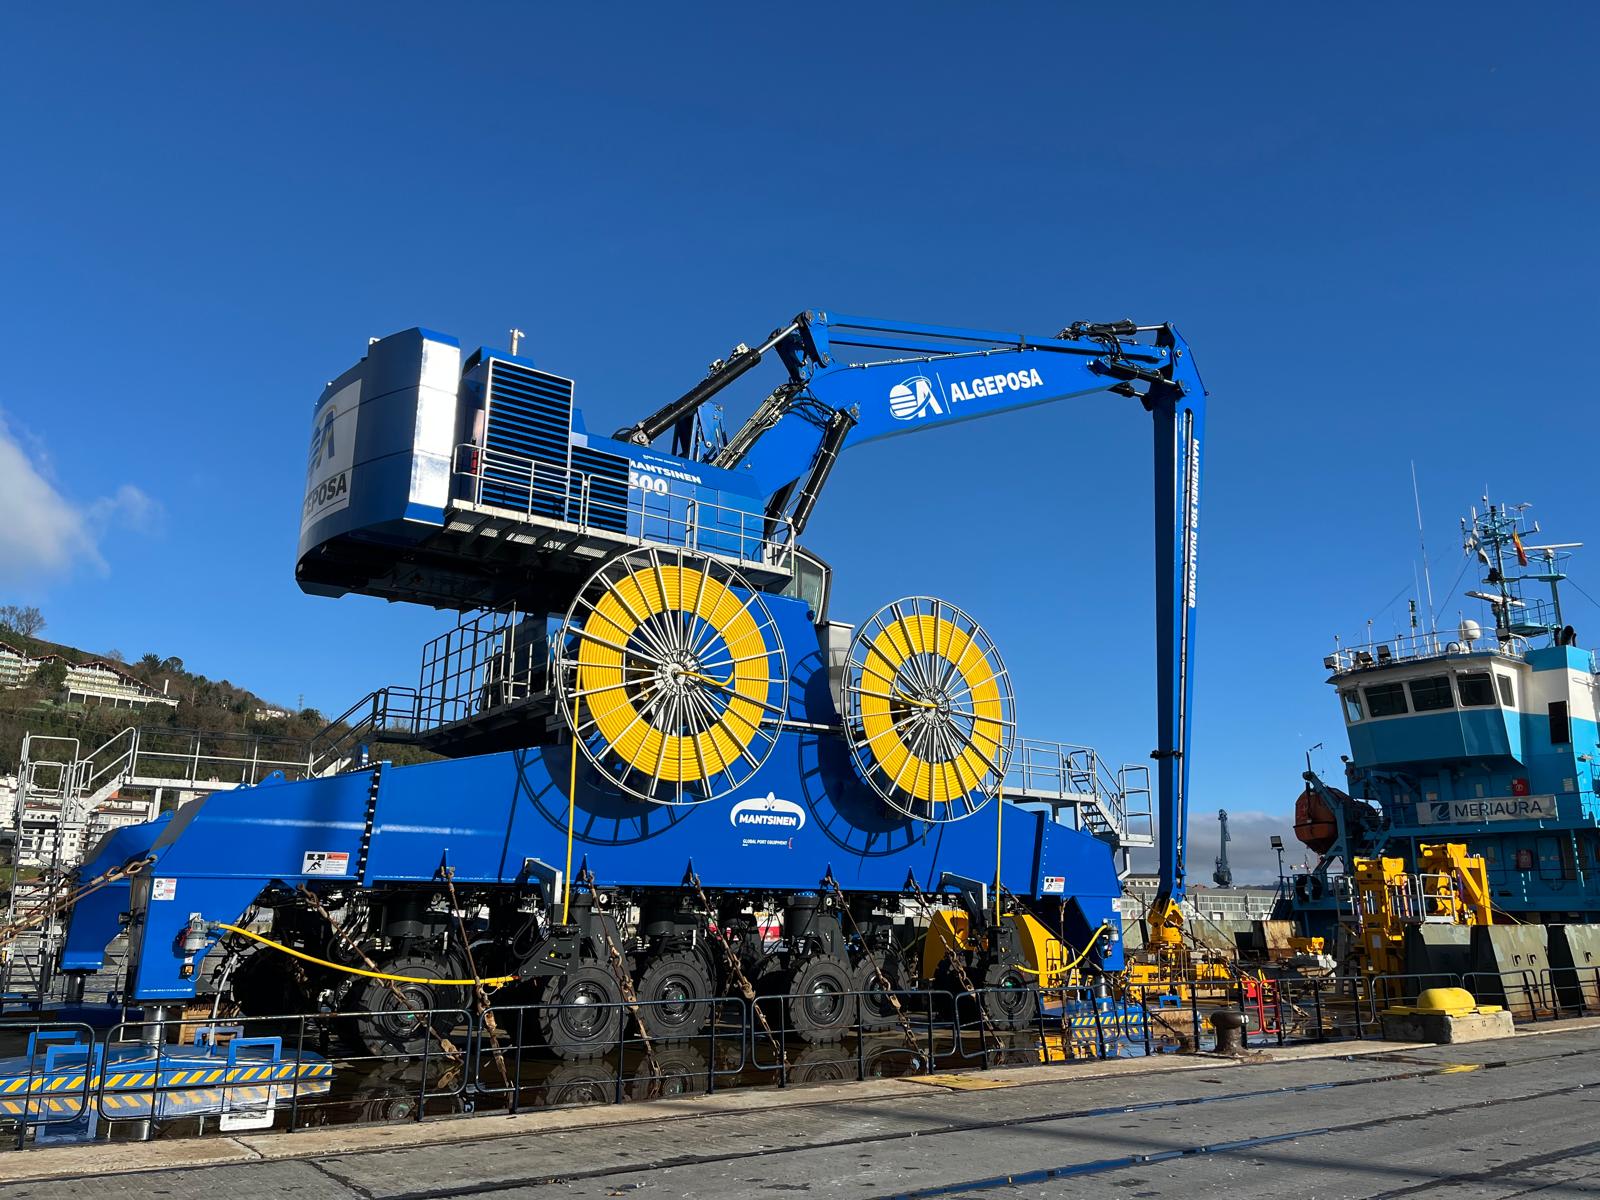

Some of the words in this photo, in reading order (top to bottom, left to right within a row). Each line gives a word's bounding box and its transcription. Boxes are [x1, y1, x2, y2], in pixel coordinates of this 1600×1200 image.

[950, 368, 1043, 402] ALGEPOSA
[629, 460, 702, 485] MANTSINEN
[1192, 438, 1200, 505] MANTSINEN
[1188, 531, 1197, 608] DUALPOWER
[739, 813, 797, 826] MANTSINEN
[1454, 800, 1543, 817] MERIAURA
